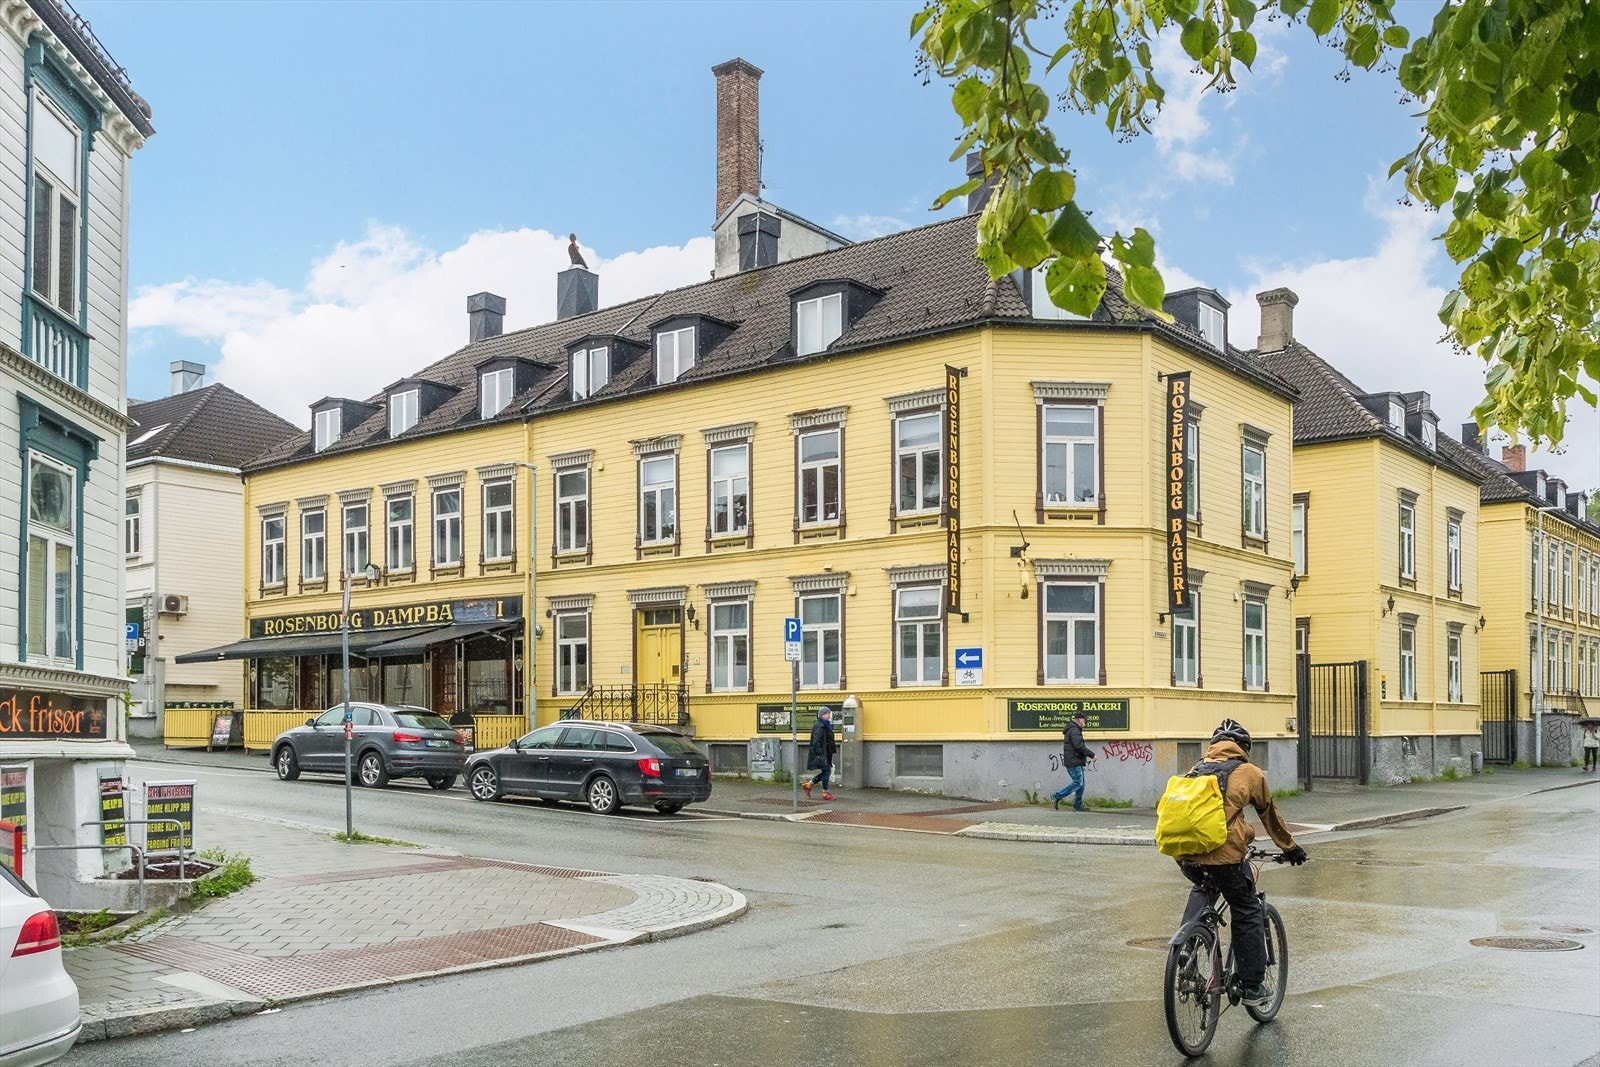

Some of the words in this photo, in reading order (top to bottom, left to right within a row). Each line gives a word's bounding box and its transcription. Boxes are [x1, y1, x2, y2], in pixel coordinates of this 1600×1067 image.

[949, 375, 959, 510] ROSENBORG
[1170, 380, 1186, 511] ROSENBORG
[949, 518, 958, 607] BAGERI
[1170, 518, 1185, 606] BAGERI
[789, 621, 797, 639] P
[29, 695, 85, 734] frisør
[1017, 702, 1078, 711] ROSENBORG
[1082, 702, 1121, 711] BAKERI
